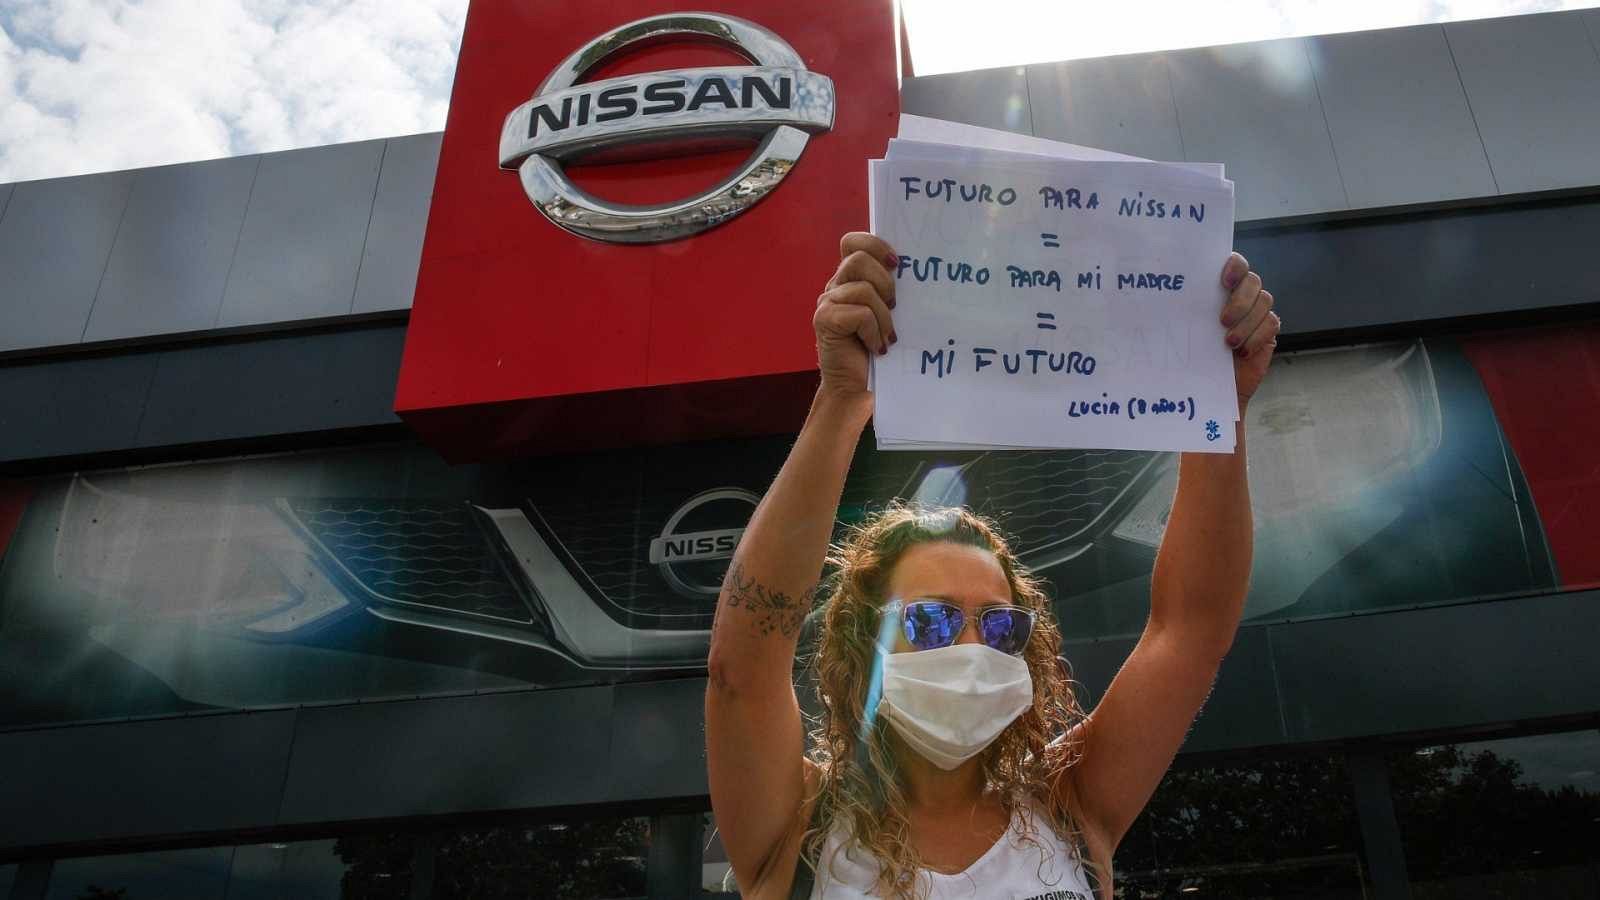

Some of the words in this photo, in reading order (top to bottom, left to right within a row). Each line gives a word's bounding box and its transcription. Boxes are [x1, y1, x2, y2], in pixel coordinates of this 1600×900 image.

[528, 77, 791, 139] NISSAN
[900, 177, 1016, 206] FUTURO
[1039, 187, 1100, 210] PARA
[1041, 233, 1060, 248] =
[897, 255, 990, 285] FUTURO
[1006, 265, 1061, 292] PARA
[1118, 272, 1185, 290] MADRE
[1036, 312, 1057, 330] =
[973, 347, 1096, 376] FUTURO
[664, 536, 734, 557] NISS
